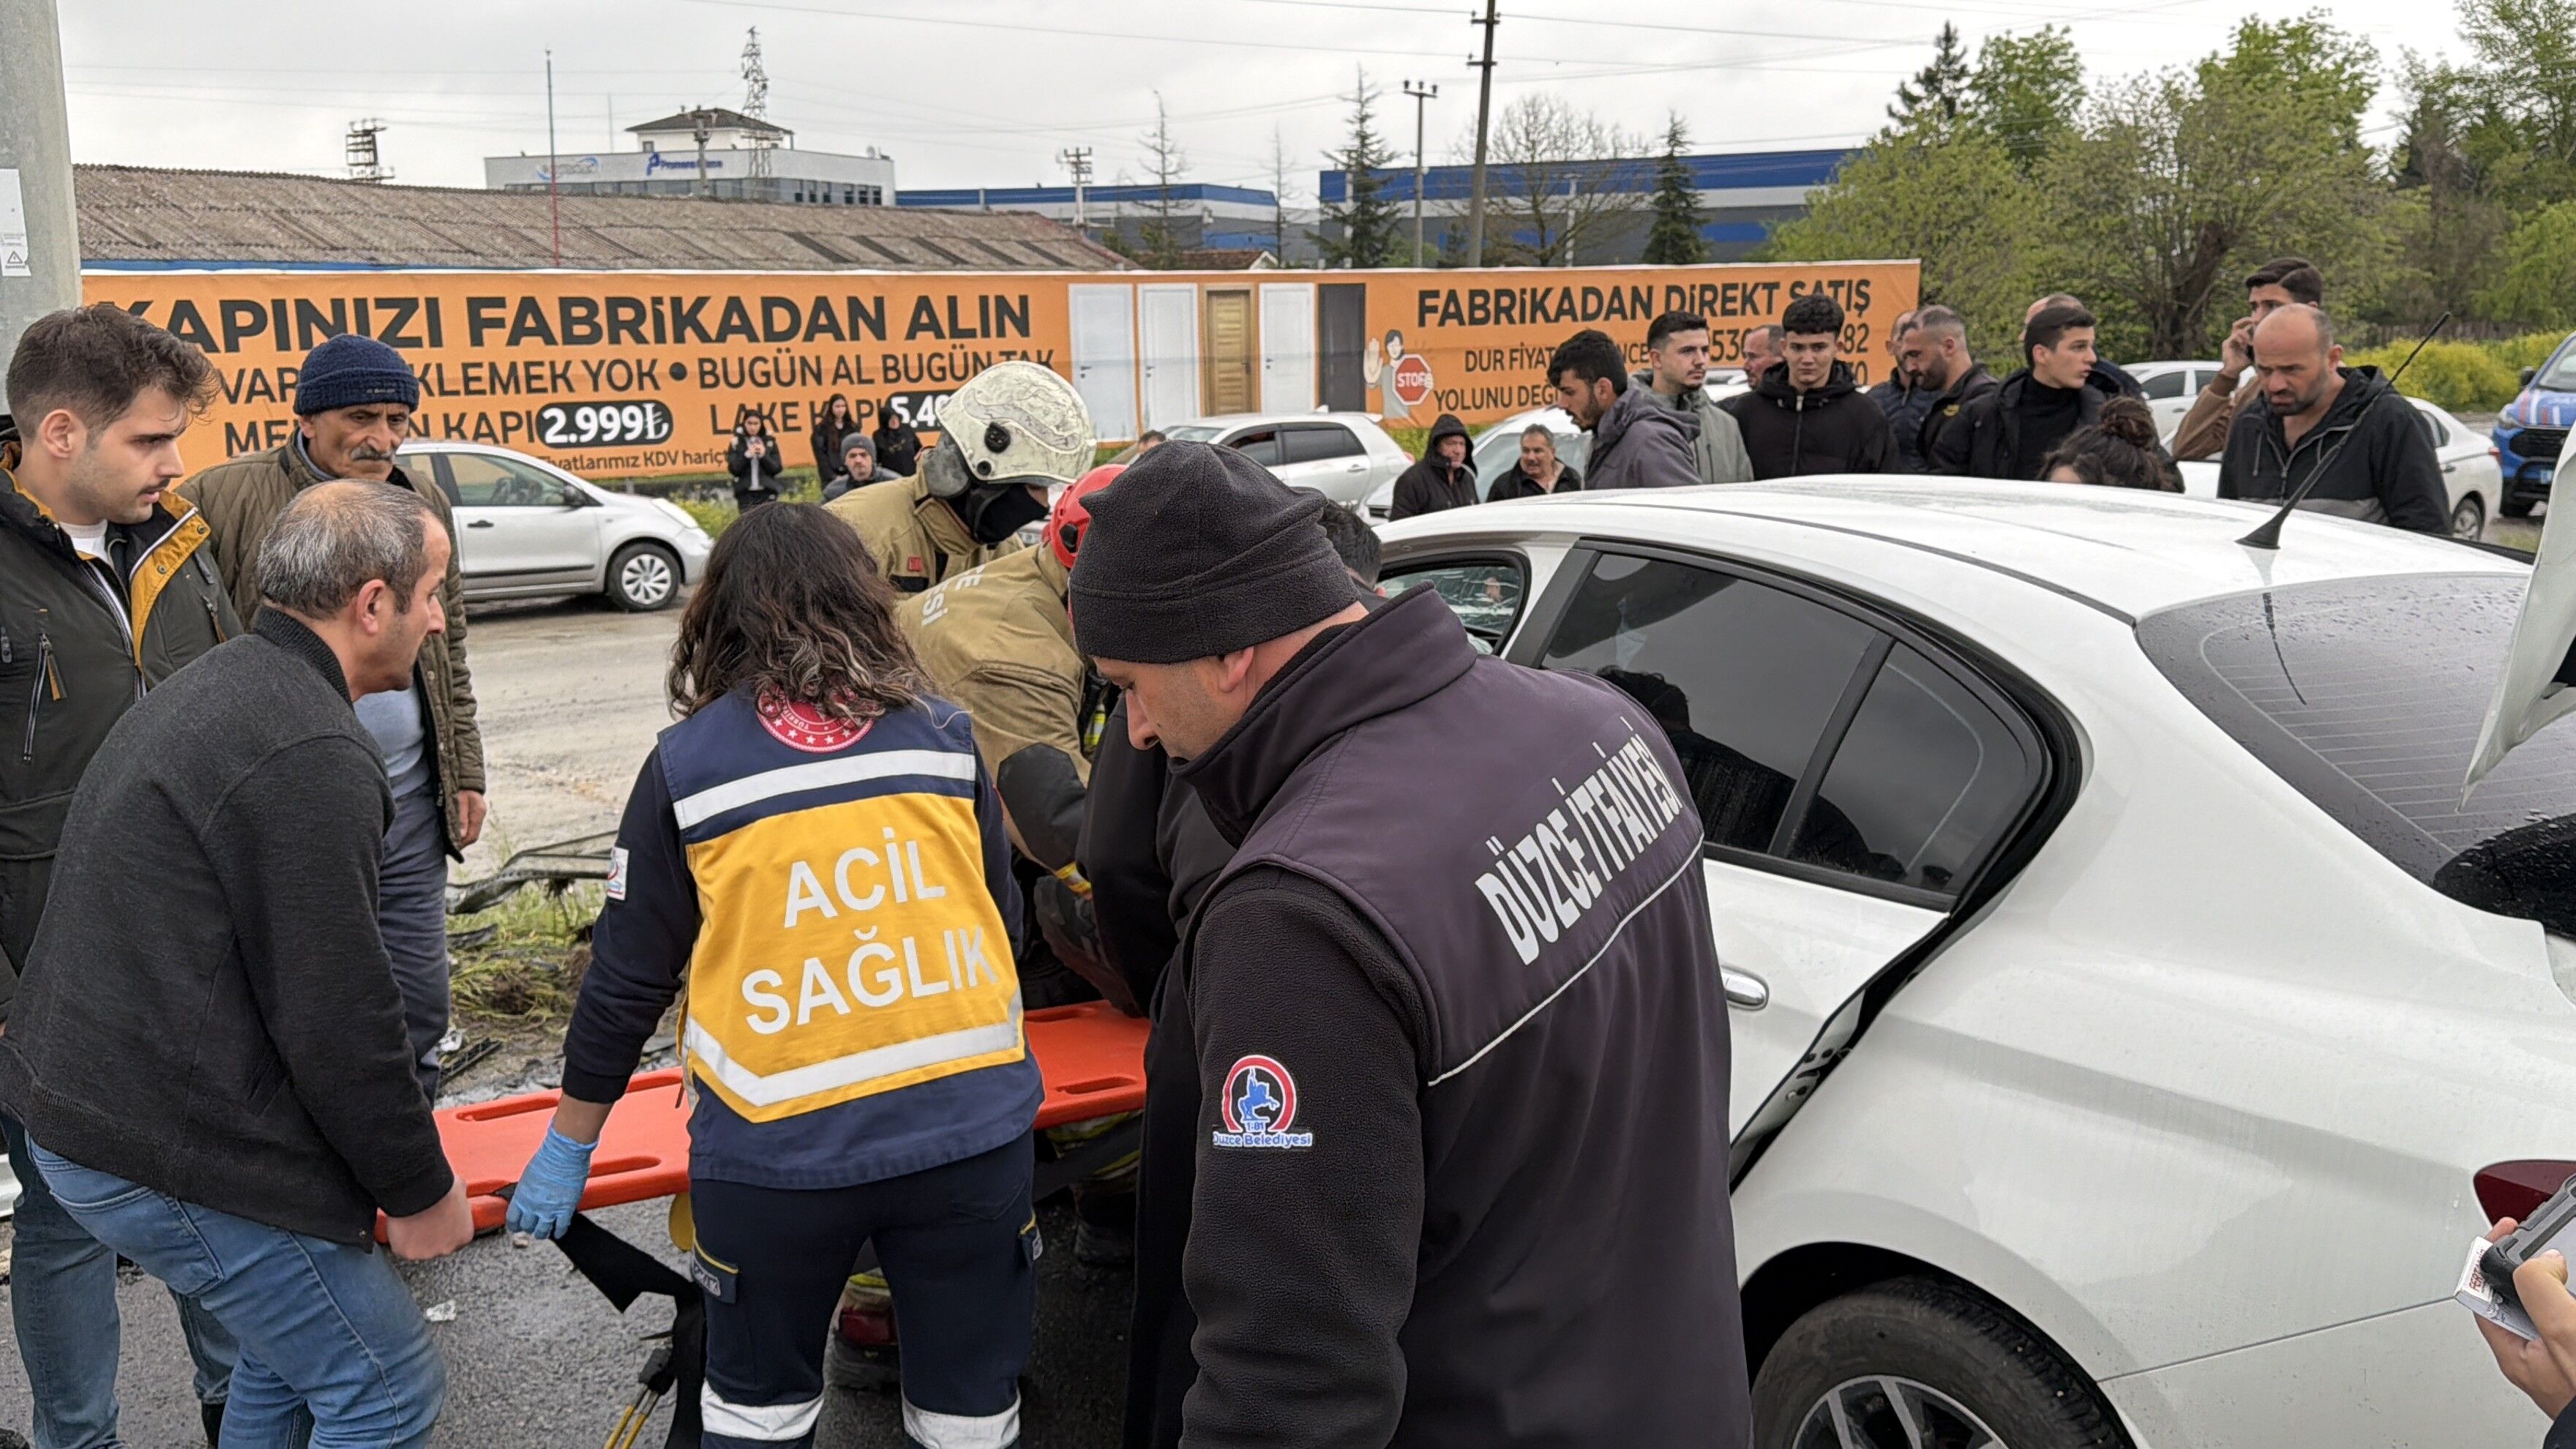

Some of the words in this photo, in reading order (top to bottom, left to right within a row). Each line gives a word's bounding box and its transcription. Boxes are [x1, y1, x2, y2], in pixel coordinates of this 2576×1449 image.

[98, 296, 443, 354] APINIZI
[905, 293, 1030, 341] ALIN
[408, 360, 576, 397] KLEMEK
[580, 358, 659, 392] YOK
[697, 347, 823, 389] BUGÜN
[831, 354, 875, 386] AL
[881, 343, 992, 384] BUGÜN
[1465, 348, 1505, 372] DUR
[1509, 342, 1557, 371] FİYAT
[1434, 386, 1513, 411] YOLUNU
[443, 411, 535, 444] KAPI
[643, 449, 680, 468] KDV
[682, 448, 730, 468] hariçt
[783, 826, 946, 928] ACİL
[1474, 807, 1603, 966] DÜZCE
[741, 925, 999, 1036] SAĞLIK
[1244, 1134, 1312, 1147] Belediyesi
